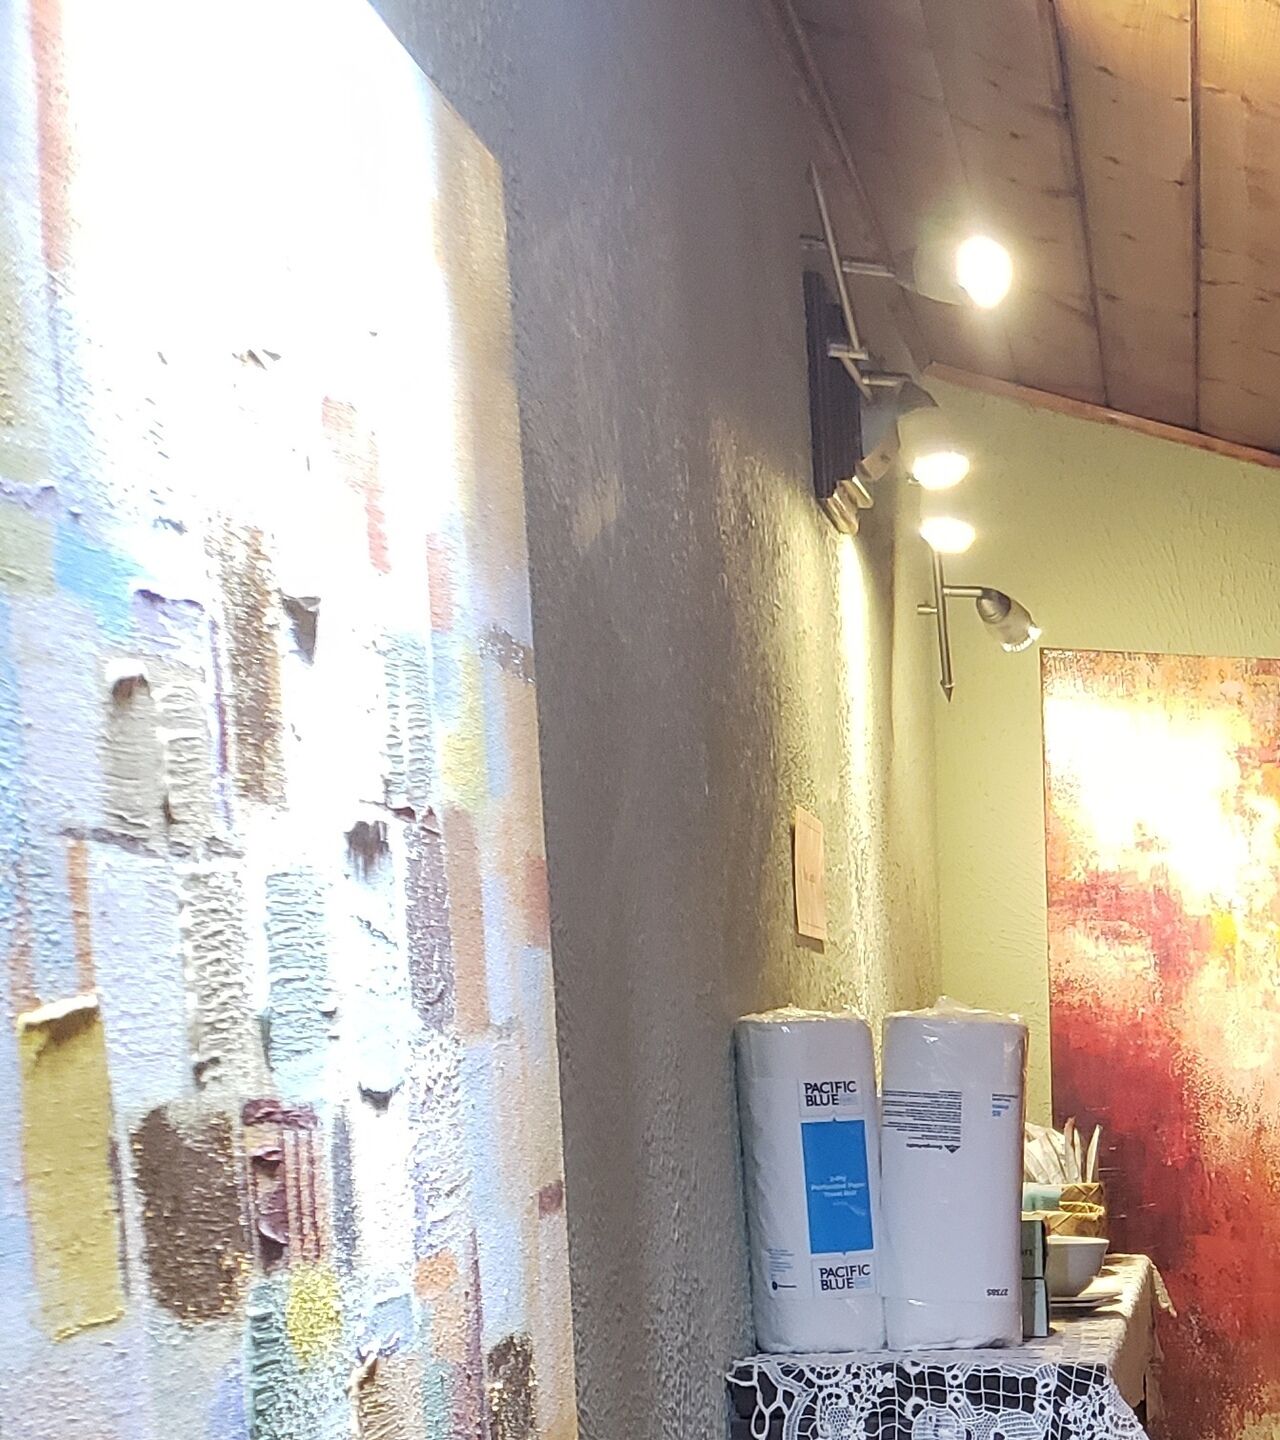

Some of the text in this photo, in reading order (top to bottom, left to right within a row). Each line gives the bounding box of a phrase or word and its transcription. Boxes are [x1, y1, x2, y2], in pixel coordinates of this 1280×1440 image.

[803, 1081, 857, 1095] PACIFIC
[805, 1094, 840, 1107] BLUE
[818, 1264, 871, 1278] PACIFIC
[820, 1278, 855, 1291] BLUE
